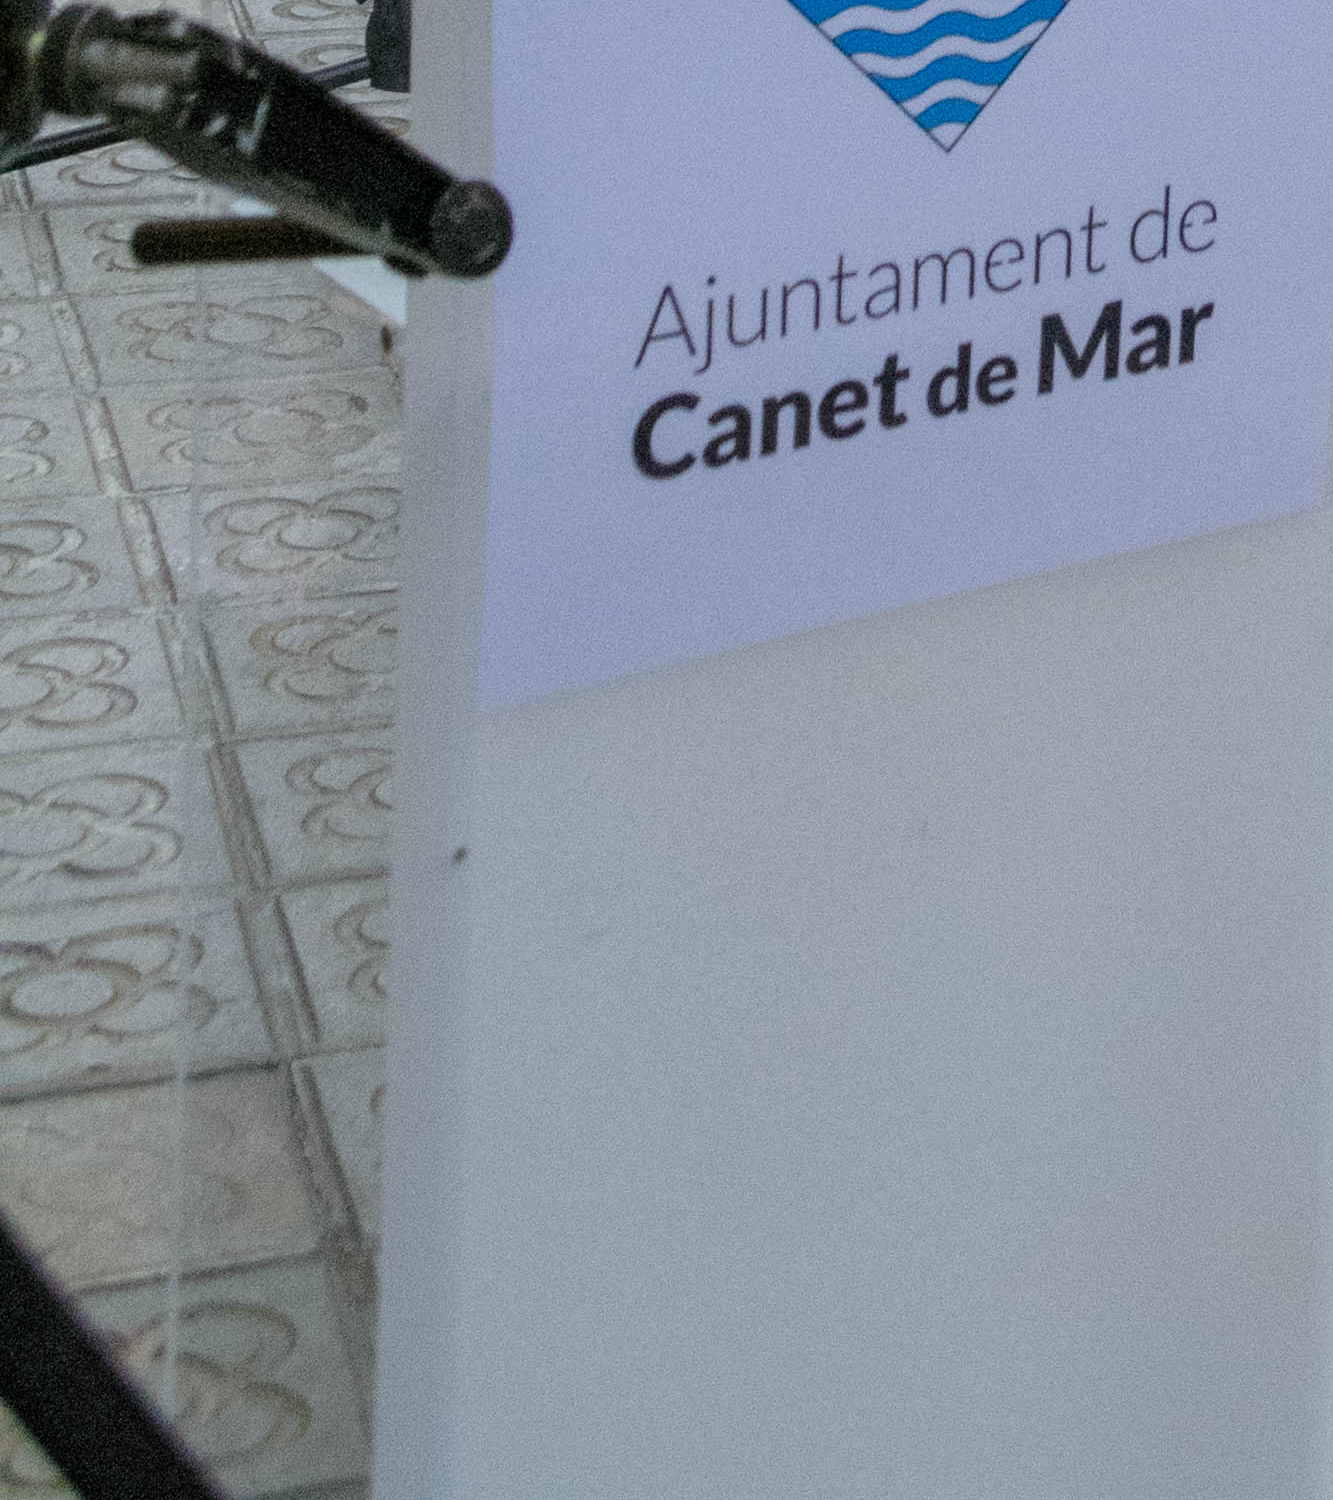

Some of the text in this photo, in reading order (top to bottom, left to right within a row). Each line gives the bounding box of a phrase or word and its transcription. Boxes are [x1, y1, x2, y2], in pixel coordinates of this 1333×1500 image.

[633, 184, 1219, 377] Ajuntament de
[629, 298, 1217, 483] Canet de Mar
